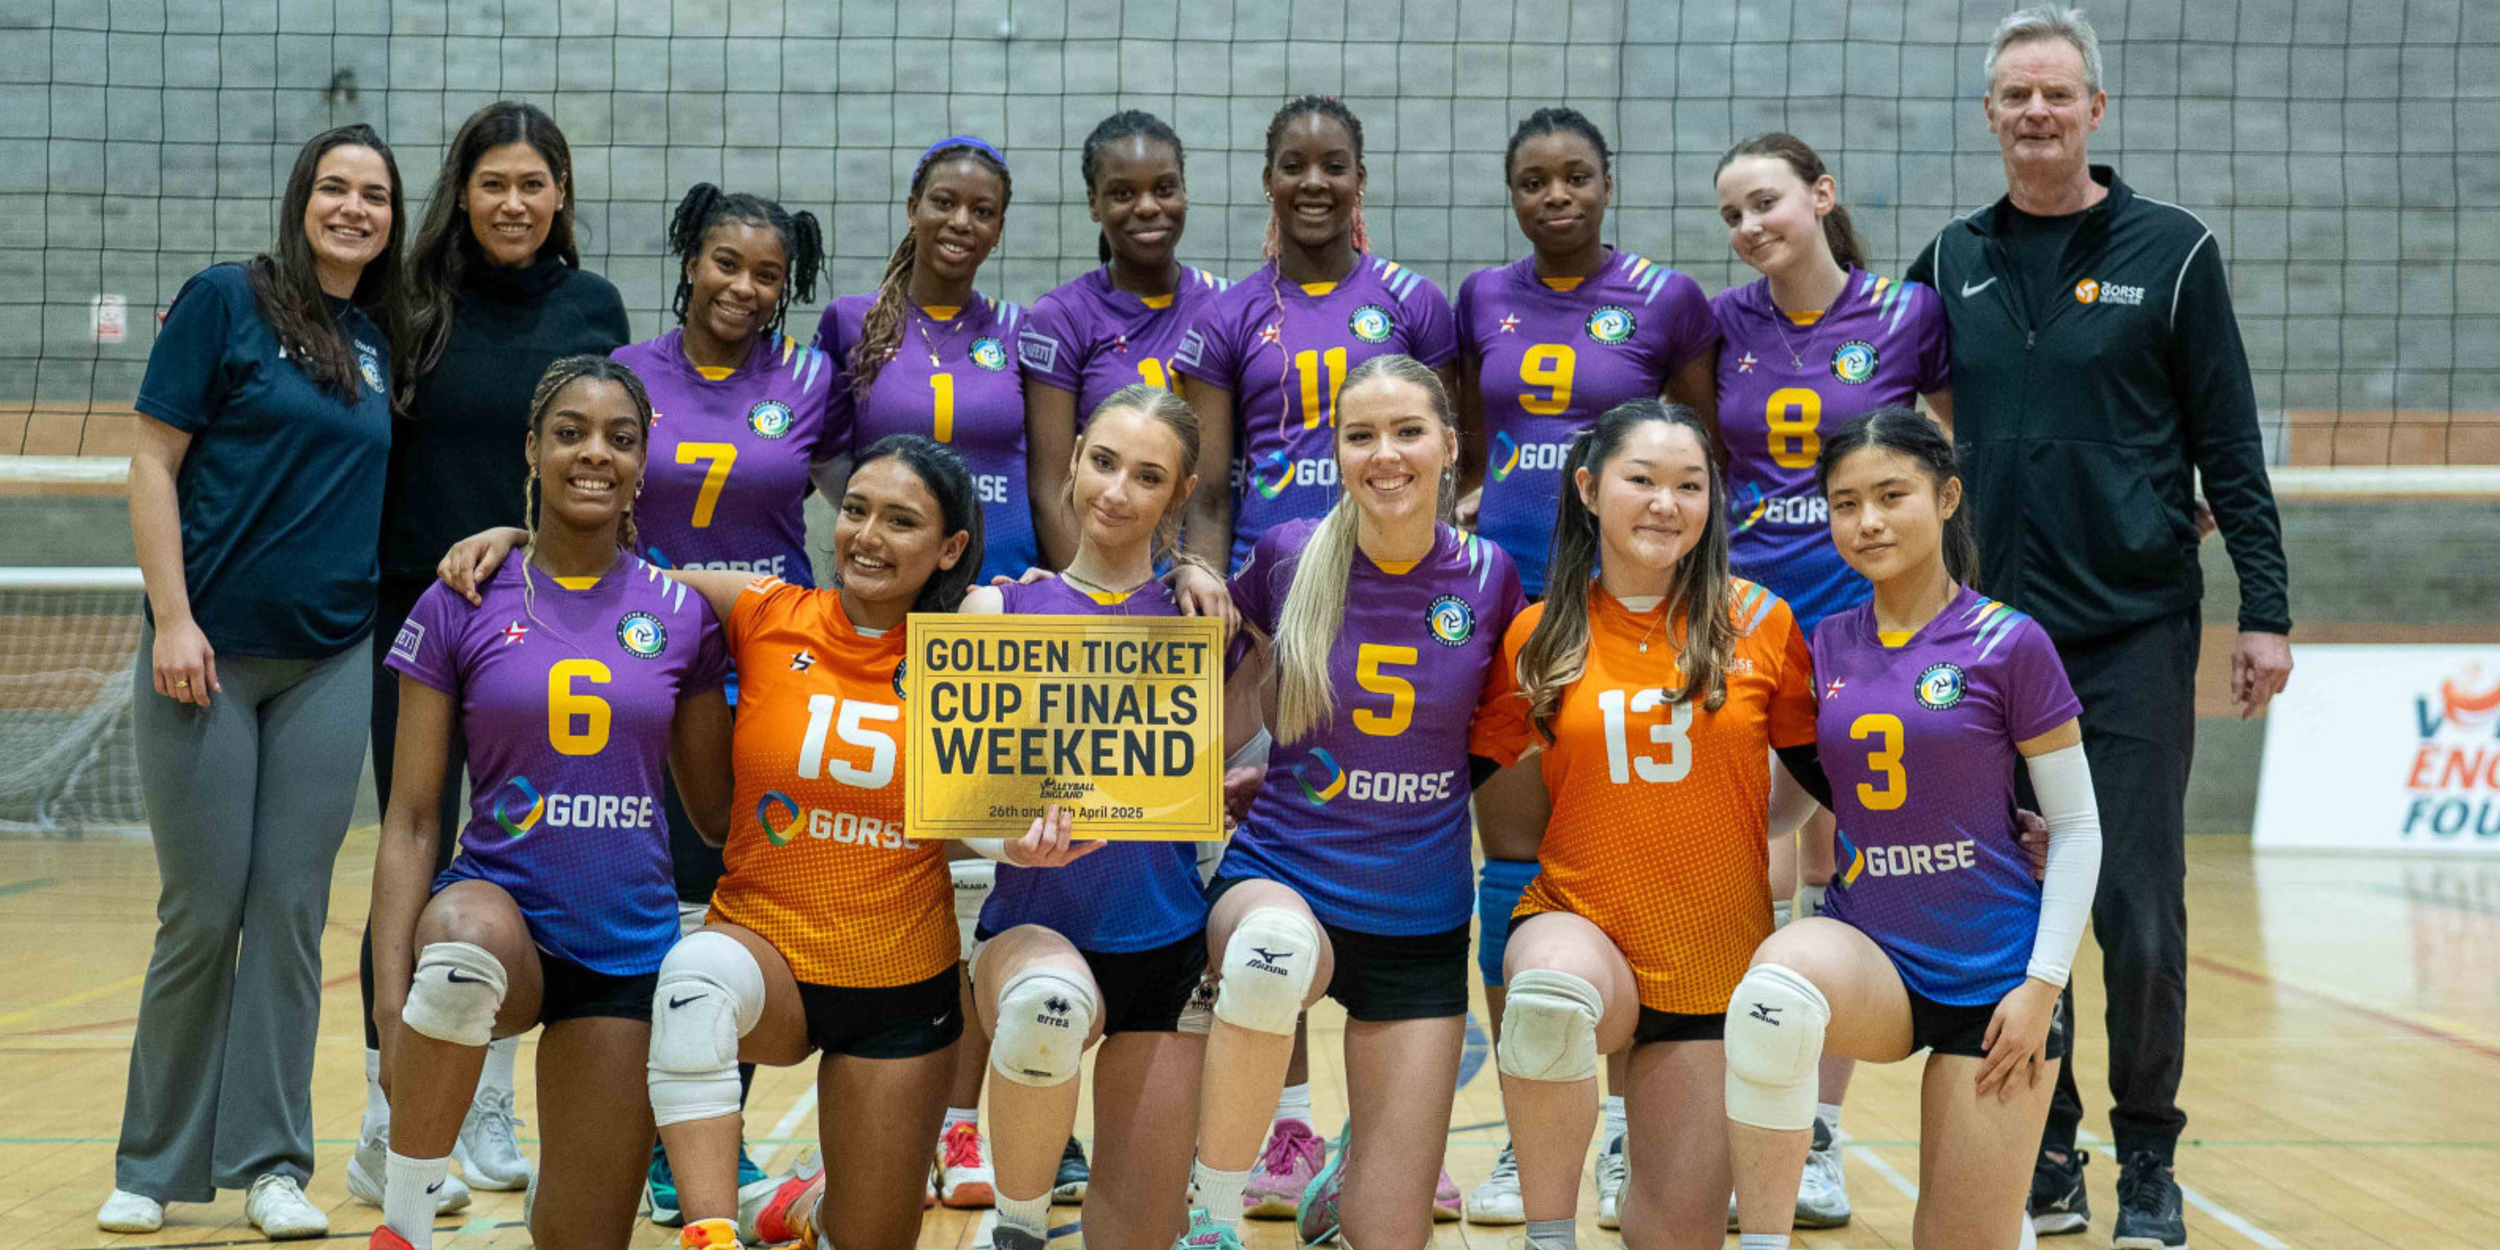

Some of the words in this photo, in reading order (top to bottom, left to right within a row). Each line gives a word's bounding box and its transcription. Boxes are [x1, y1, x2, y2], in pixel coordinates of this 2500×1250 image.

[930, 373, 954, 443] 1
[1295, 346, 1347, 430] 11
[1519, 343, 1577, 416] 9
[1766, 387, 1822, 469] 8
[674, 442, 738, 528] 7
[926, 638, 1069, 673] GOLDEN
[1082, 640, 1208, 675] TICKET
[1352, 642, 1418, 737] 5
[548, 659, 613, 756] 6
[930, 681, 1022, 723] CUP
[1038, 683, 1198, 726] FINALS
[1598, 689, 1693, 785] 13
[797, 694, 899, 790] 15
[931, 727, 1195, 777] WEEKEND
[1850, 713, 1907, 812] 3
[546, 793, 653, 829] GORSE
[988, 805, 1019, 818] 26th
[1022, 805, 1045, 818] and
[1039, 791, 1083, 800] ENGLAND
[1079, 805, 1108, 820] April
[1111, 806, 1144, 819] 2025
[1348, 771, 1455, 803] GORSE
[1867, 839, 1976, 877] GORSE
